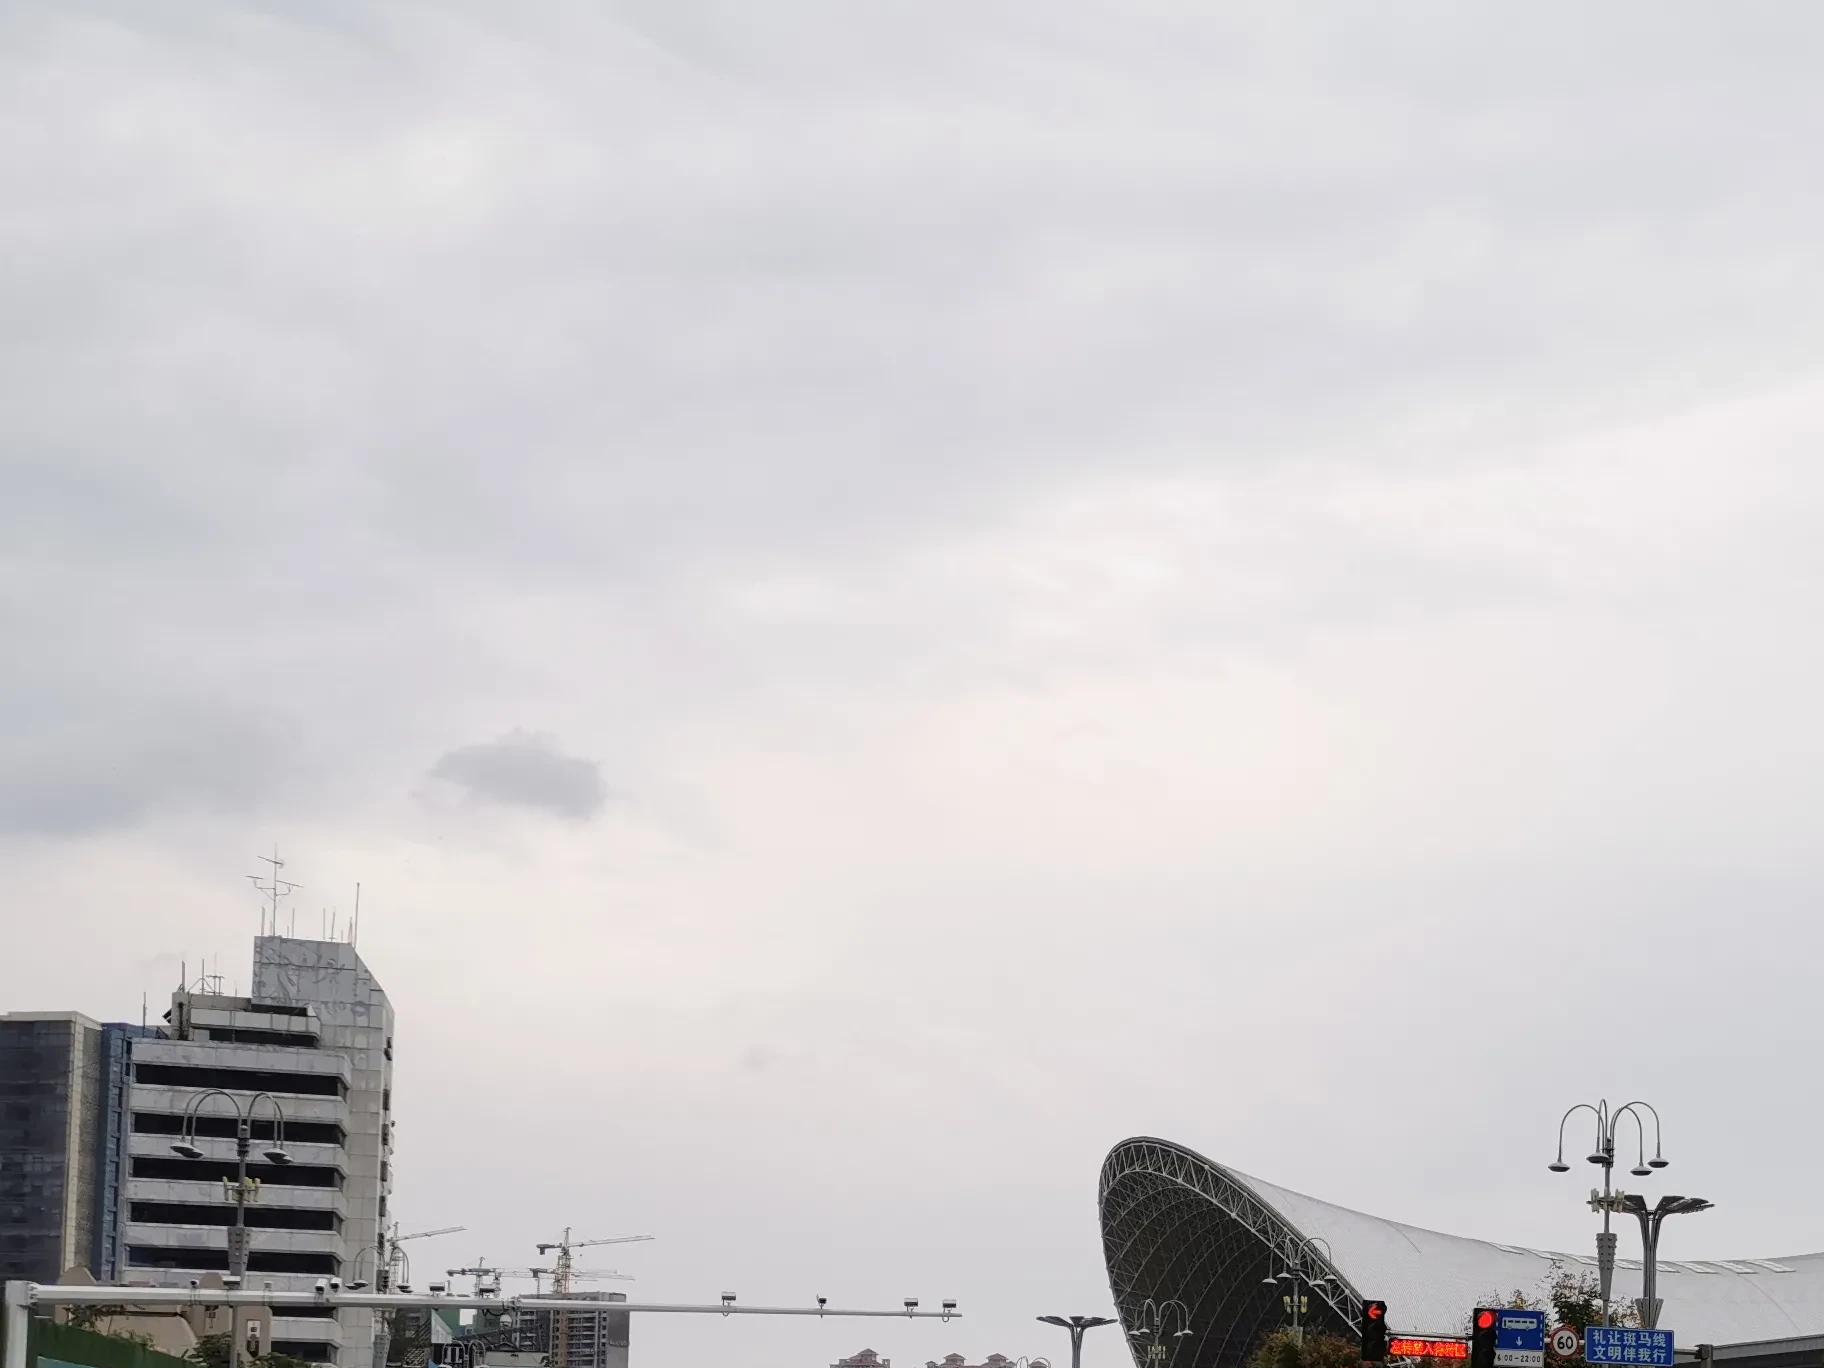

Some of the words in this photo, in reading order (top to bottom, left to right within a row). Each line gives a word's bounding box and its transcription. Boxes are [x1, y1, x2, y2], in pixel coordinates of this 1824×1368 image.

[1557, 1336, 1574, 1350] 60
[1592, 1329, 1667, 1347] 礼让斑马线
[1593, 1346, 1667, 1363] 文明伴我行
